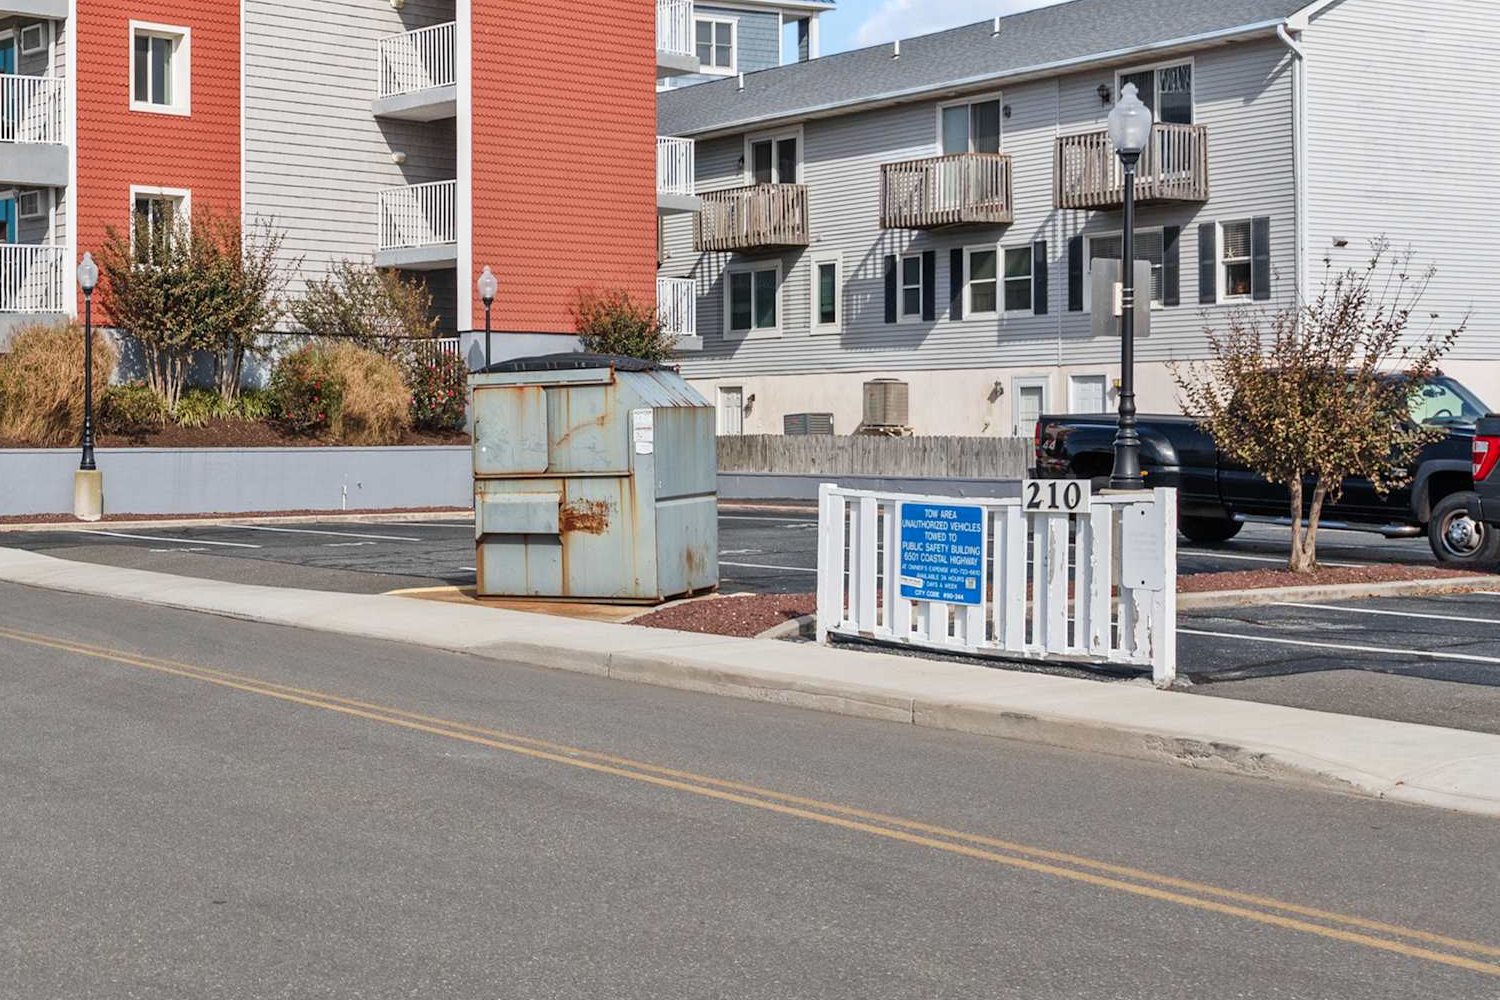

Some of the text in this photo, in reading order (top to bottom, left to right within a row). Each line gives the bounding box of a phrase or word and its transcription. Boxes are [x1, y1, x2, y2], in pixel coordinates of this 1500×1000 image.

[1027, 482, 1082, 510] 210
[924, 509, 958, 519] TOW AREA
[901, 519, 982, 533] UNAUTHORIZED VEHICLES
[924, 531, 958, 543] TOWED TO
[902, 541, 981, 556] PUBLIC SAFETY BUILDING
[920, 553, 948, 564] COASTAL
[949, 556, 978, 566] HIGHWAY
[916, 572, 940, 580] AVAILABLE
[926, 580, 939, 588] DAYS
[926, 590, 940, 598] CODE
